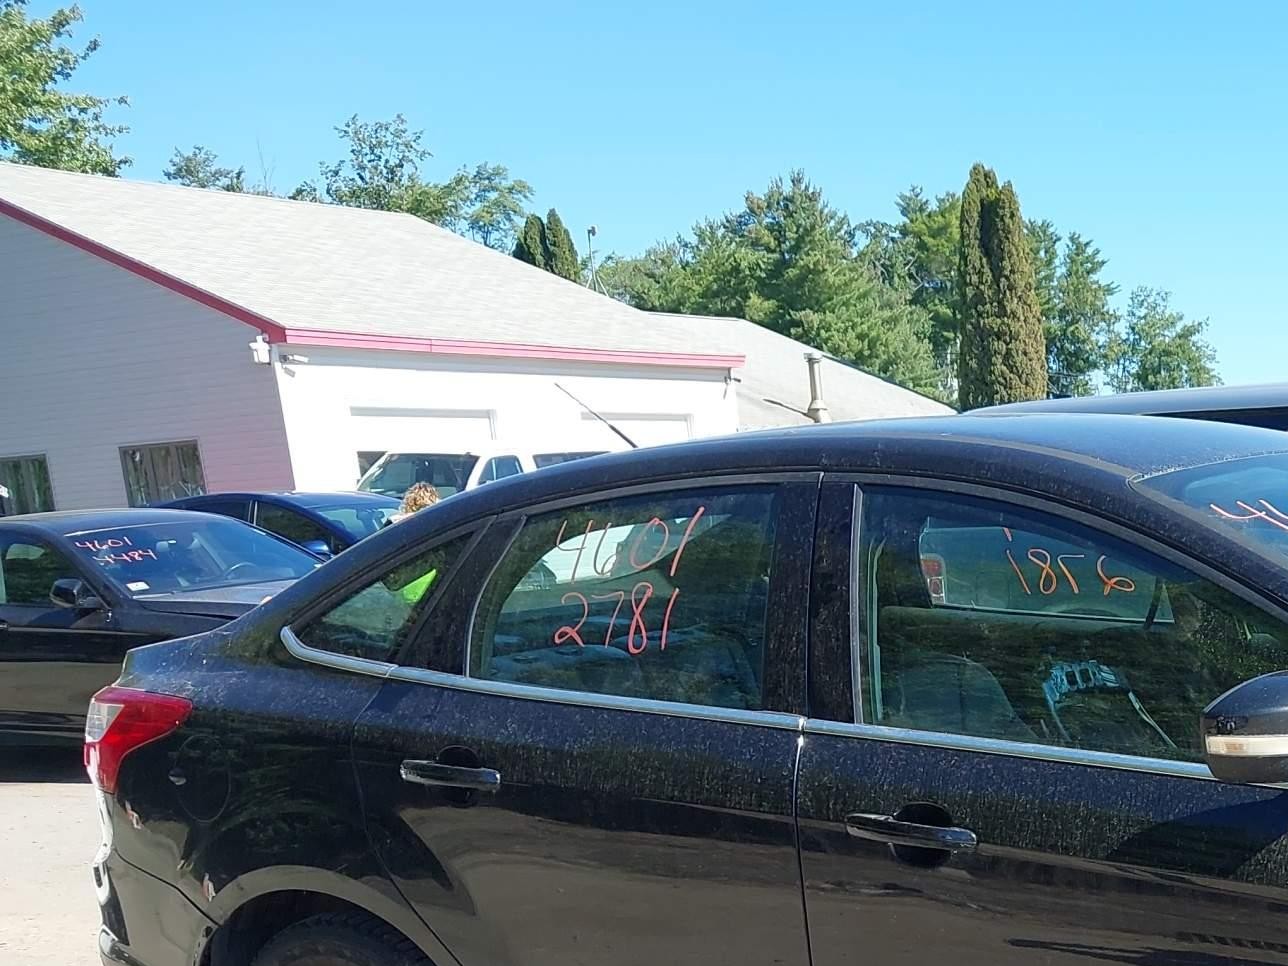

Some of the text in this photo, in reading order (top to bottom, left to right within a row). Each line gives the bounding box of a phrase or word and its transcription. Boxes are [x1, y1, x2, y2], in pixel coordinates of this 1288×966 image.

[75, 536, 132, 551] 4601
[92, 549, 157, 564] 4484
[556, 506, 705, 585] 4601
[555, 582, 680, 654] 2781
